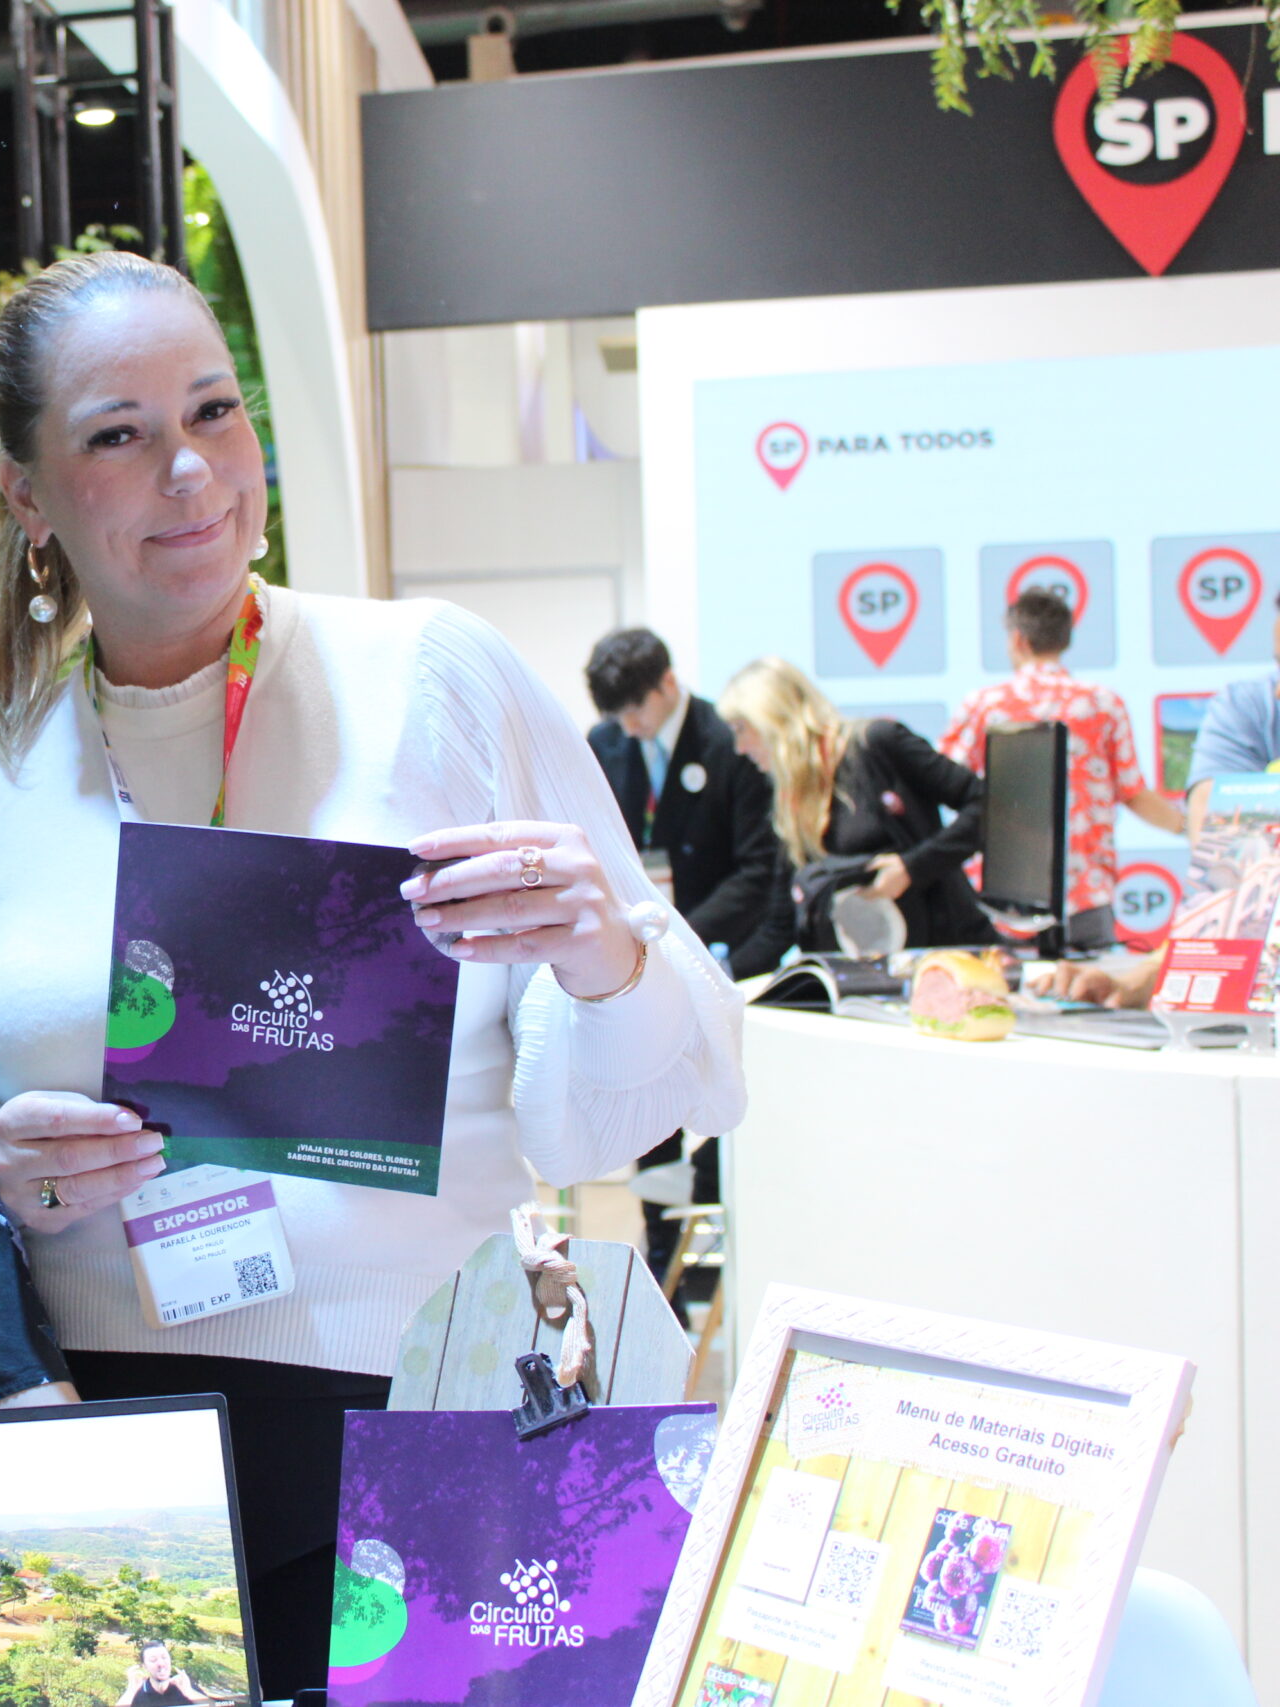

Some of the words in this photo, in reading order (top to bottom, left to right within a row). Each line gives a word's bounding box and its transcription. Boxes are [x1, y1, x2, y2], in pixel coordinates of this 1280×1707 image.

[1094, 97, 1210, 166] SP
[817, 436, 890, 453] PARA
[900, 430, 993, 450] TODOS
[1199, 576, 1244, 600] SP
[858, 591, 901, 615] SP
[1121, 890, 1166, 915] SP
[231, 1003, 308, 1029] Circuito
[231, 1023, 250, 1033] DAS
[252, 1025, 334, 1052] FRUTAS
[287, 1152, 320, 1163] SABORES
[322, 1156, 335, 1165] DEL
[337, 1158, 371, 1169] CIRCUITO
[372, 1163, 387, 1172] DAS
[388, 1165, 419, 1177] FRUTAS!
[324, 1147, 334, 1155] EN
[335, 1148, 348, 1157] LOS
[385, 1155, 412, 1166] OLORES
[414, 1159, 420, 1167] Y
[153, 1195, 249, 1233] EXPOSITOR
[160, 1234, 197, 1250] RAFAELA
[210, 1292, 231, 1306] EXP
[802, 1406, 844, 1425] Circuito
[815, 1412, 860, 1434] FRUTAS
[896, 1400, 939, 1422] Menu
[945, 1409, 965, 1427] de
[969, 1414, 1045, 1445] Materiais
[1051, 1432, 1116, 1462] Digitais
[929, 1432, 989, 1459] Acesso
[995, 1446, 1065, 1476] Gratuito
[470, 1601, 554, 1624] Circuito
[470, 1626, 491, 1635] DAS
[494, 1625, 584, 1647] FRUTAS
